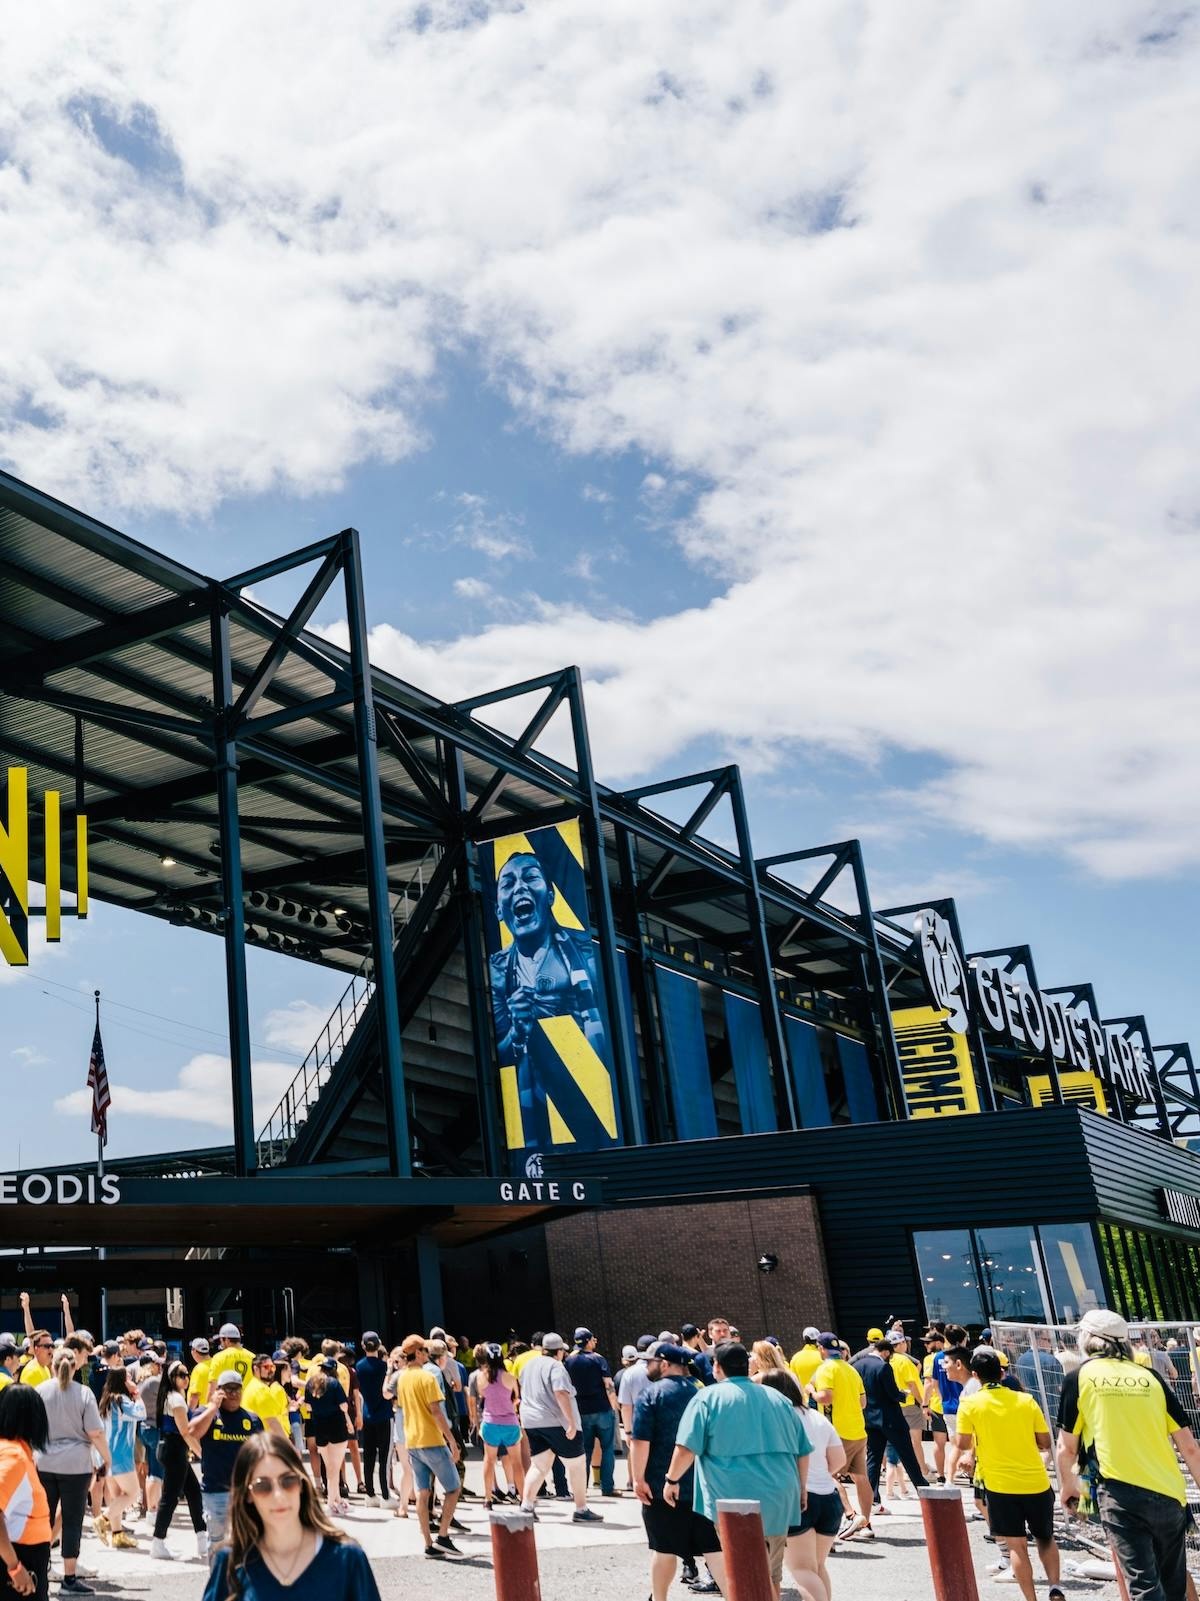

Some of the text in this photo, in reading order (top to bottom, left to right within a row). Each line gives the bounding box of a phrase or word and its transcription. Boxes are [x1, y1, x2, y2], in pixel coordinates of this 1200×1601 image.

[968, 957, 1156, 1103] GEODIS PARK
[500, 1182, 585, 1201] GATE C
[1088, 1376, 1150, 1388] YAZOO
